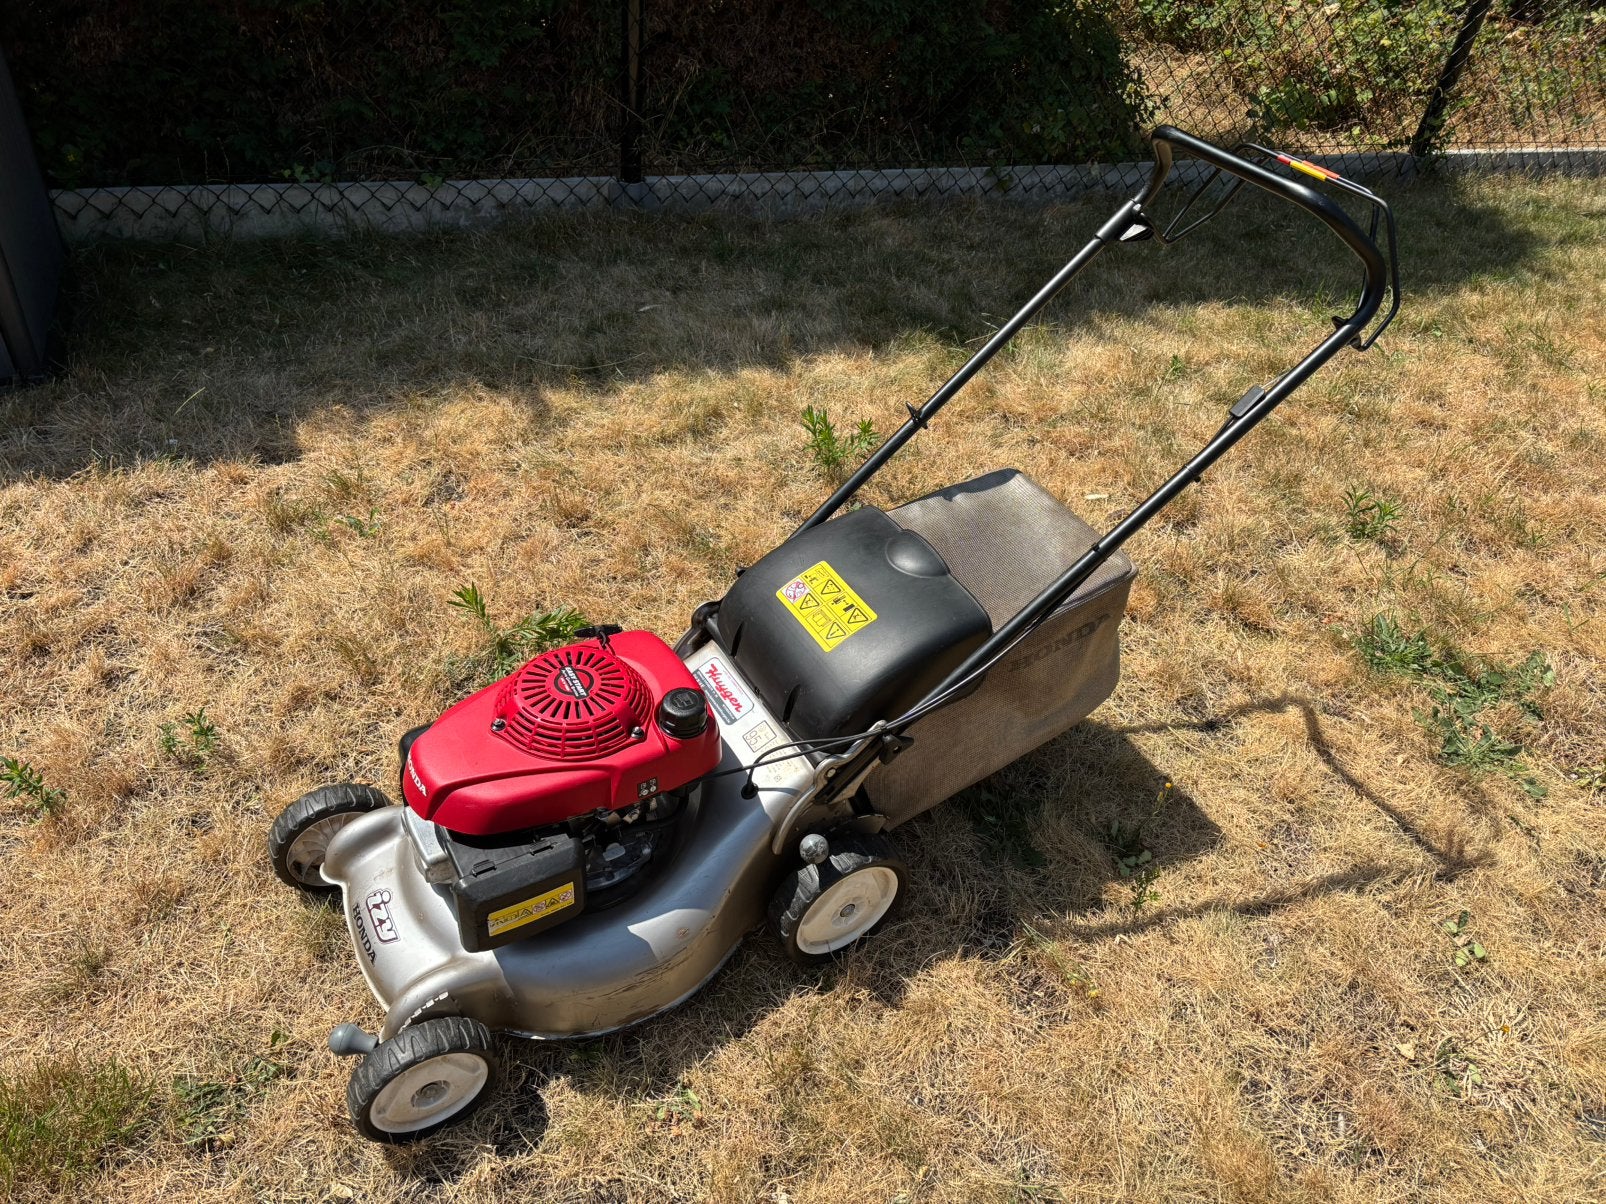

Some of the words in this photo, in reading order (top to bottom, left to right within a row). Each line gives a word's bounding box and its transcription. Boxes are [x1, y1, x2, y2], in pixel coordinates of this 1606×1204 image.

[564, 666, 578, 680] EASY
[572, 679, 587, 696] START
[705, 663, 743, 713] Huygen
[745, 730, 762, 746] 95
[352, 902, 377, 968] HONDA
